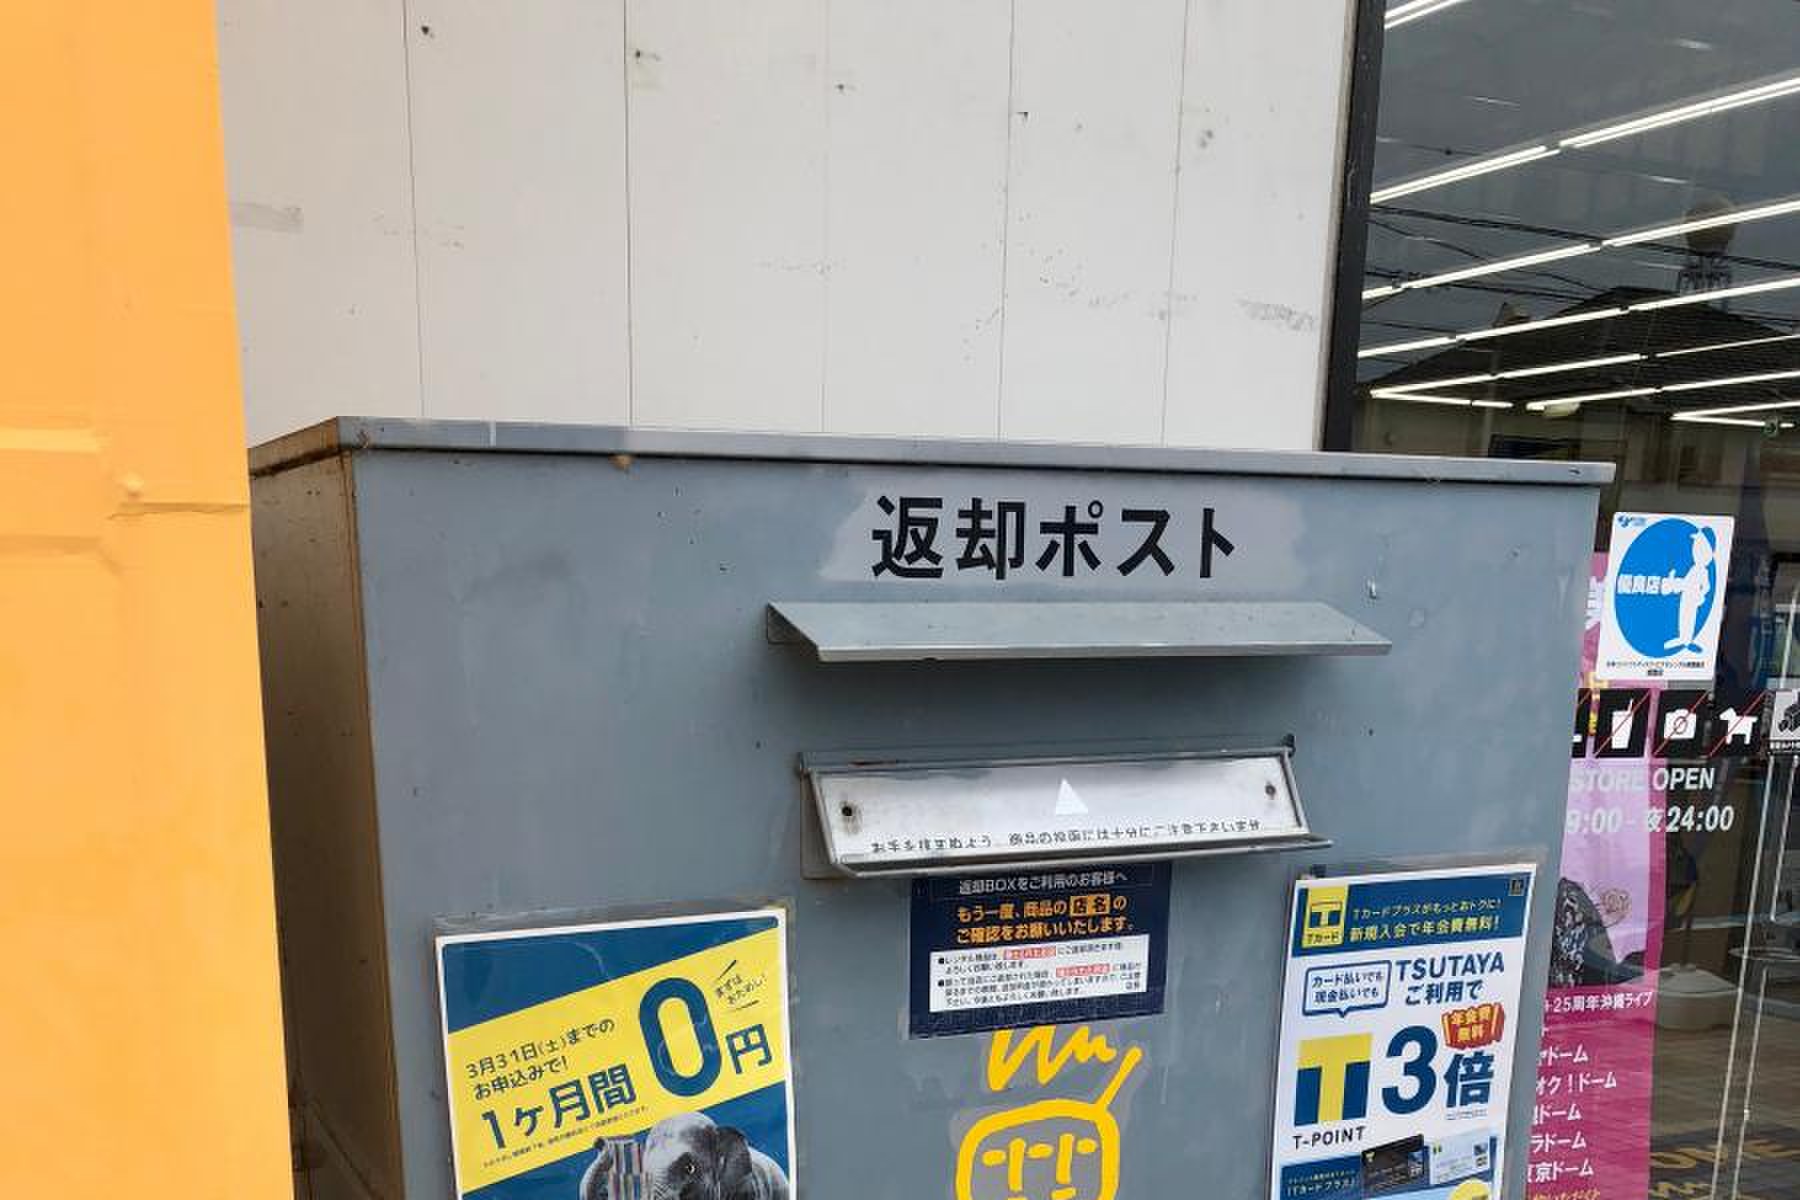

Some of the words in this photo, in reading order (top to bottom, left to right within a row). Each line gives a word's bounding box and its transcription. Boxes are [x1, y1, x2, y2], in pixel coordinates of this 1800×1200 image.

[871, 495, 1235, 580] 返却ポスト
[1652, 767, 1715, 791] OPEN
[956, 917, 1134, 944] ご確認をお願いいたします。
[1395, 951, 1505, 982] TSUTAYA
[1405, 979, 1484, 1006] ご利用で
[1381, 1025, 1495, 1115] 3倍
[1292, 1125, 1367, 1150] T-POINT
